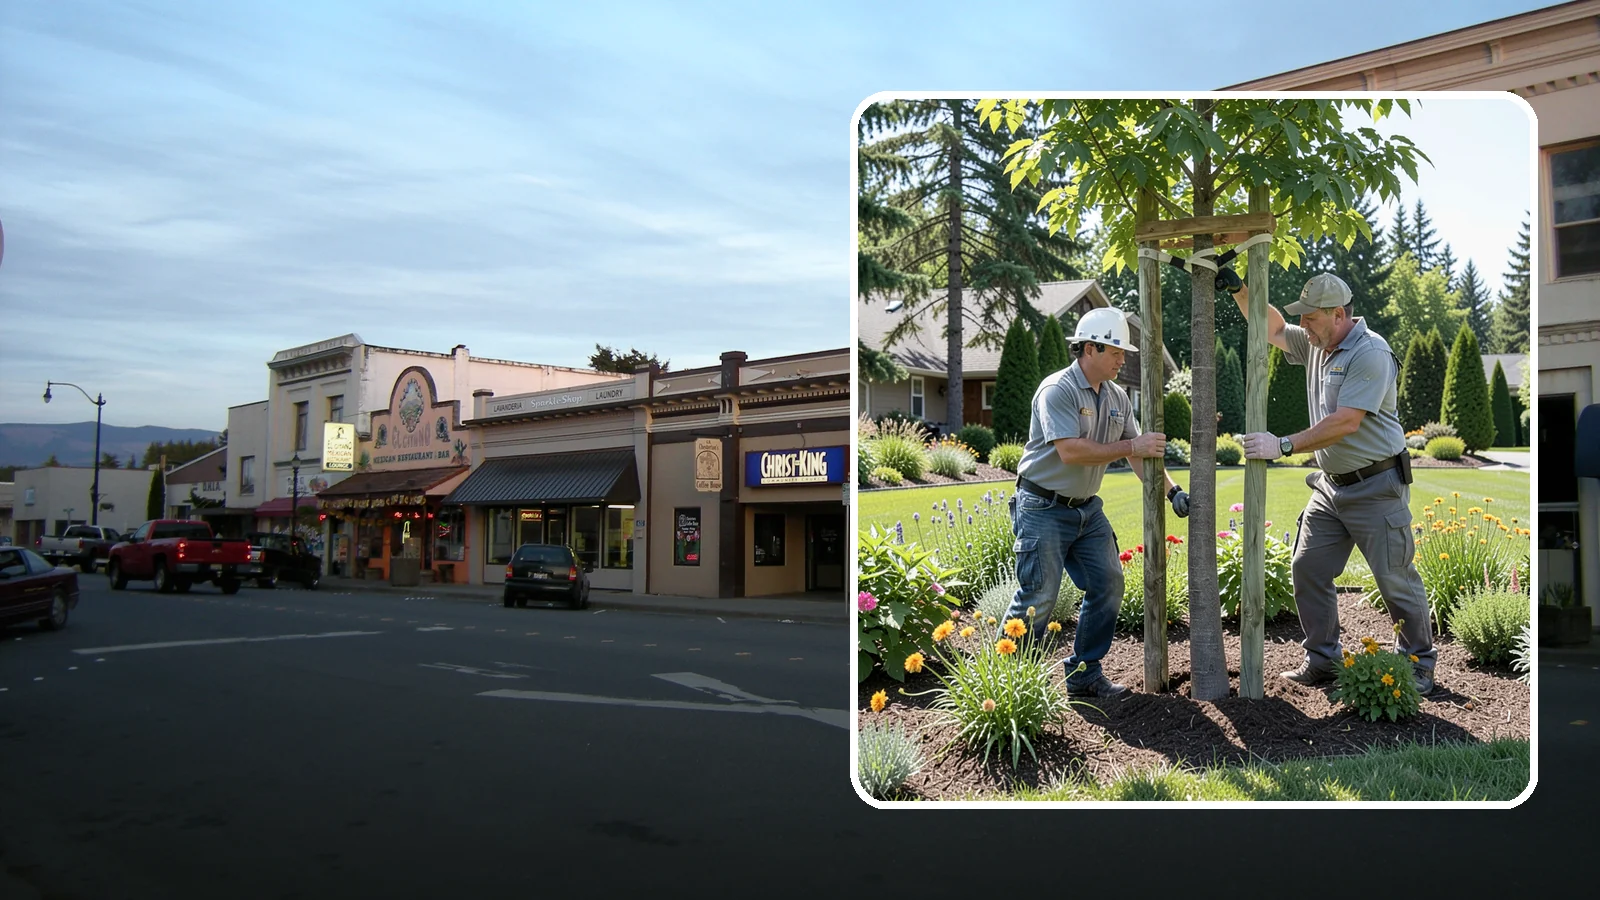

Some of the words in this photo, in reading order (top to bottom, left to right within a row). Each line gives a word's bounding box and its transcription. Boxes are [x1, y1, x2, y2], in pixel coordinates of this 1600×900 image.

[493, 402, 522, 412] LAVANDERIA
[595, 389, 623, 400] LAUNDRY
[373, 455, 396, 464] MEXICAN
[397, 451, 433, 462] RESTAURANT
[438, 450, 450, 459] BAR
[761, 452, 797, 477] CHRIST
[799, 450, 827, 476] KING
